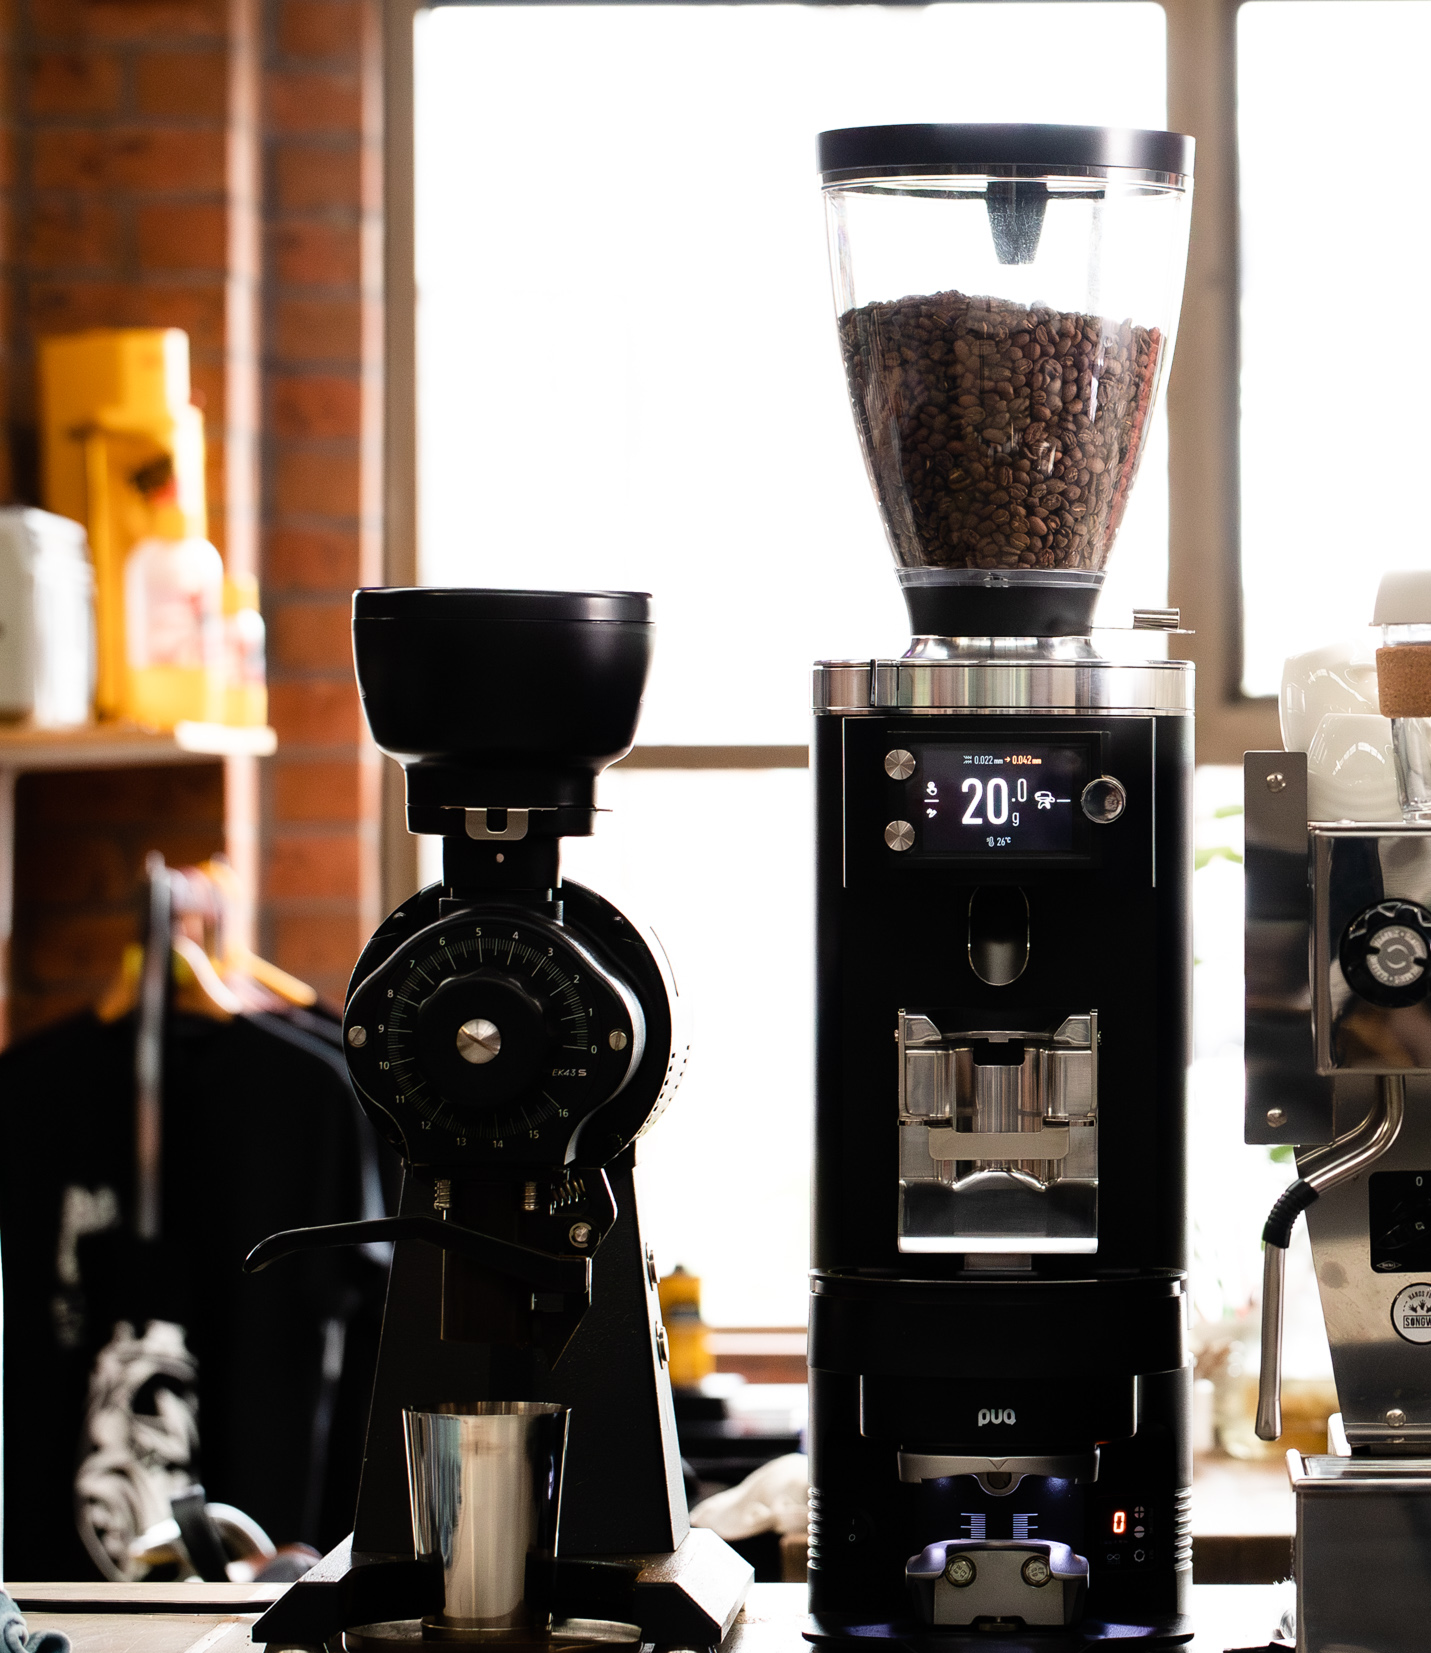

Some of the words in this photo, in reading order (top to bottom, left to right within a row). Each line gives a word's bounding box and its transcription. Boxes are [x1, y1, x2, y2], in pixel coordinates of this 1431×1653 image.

[475, 927, 482, 936] 5
[512, 931, 519, 940] 4
[439, 936, 446, 946] 6
[547, 947, 554, 956] 3
[410, 960, 416, 968] 7
[573, 974, 580, 984] 2
[387, 989, 394, 998] 8
[588, 1008, 593, 1017] 1
[378, 1024, 385, 1033] 9
[590, 1045, 598, 1054] 0
[379, 1061, 390, 1070] 10
[577, 1068, 587, 1077] S
[396, 1095, 405, 1103] 11
[558, 1108, 569, 1118] 16
[421, 1121, 431, 1130] 12
[529, 1130, 540, 1139] 15
[456, 1137, 467, 1146] 13
[493, 1140, 504, 1148] 14
[1112, 1511, 1126, 1535] 0
